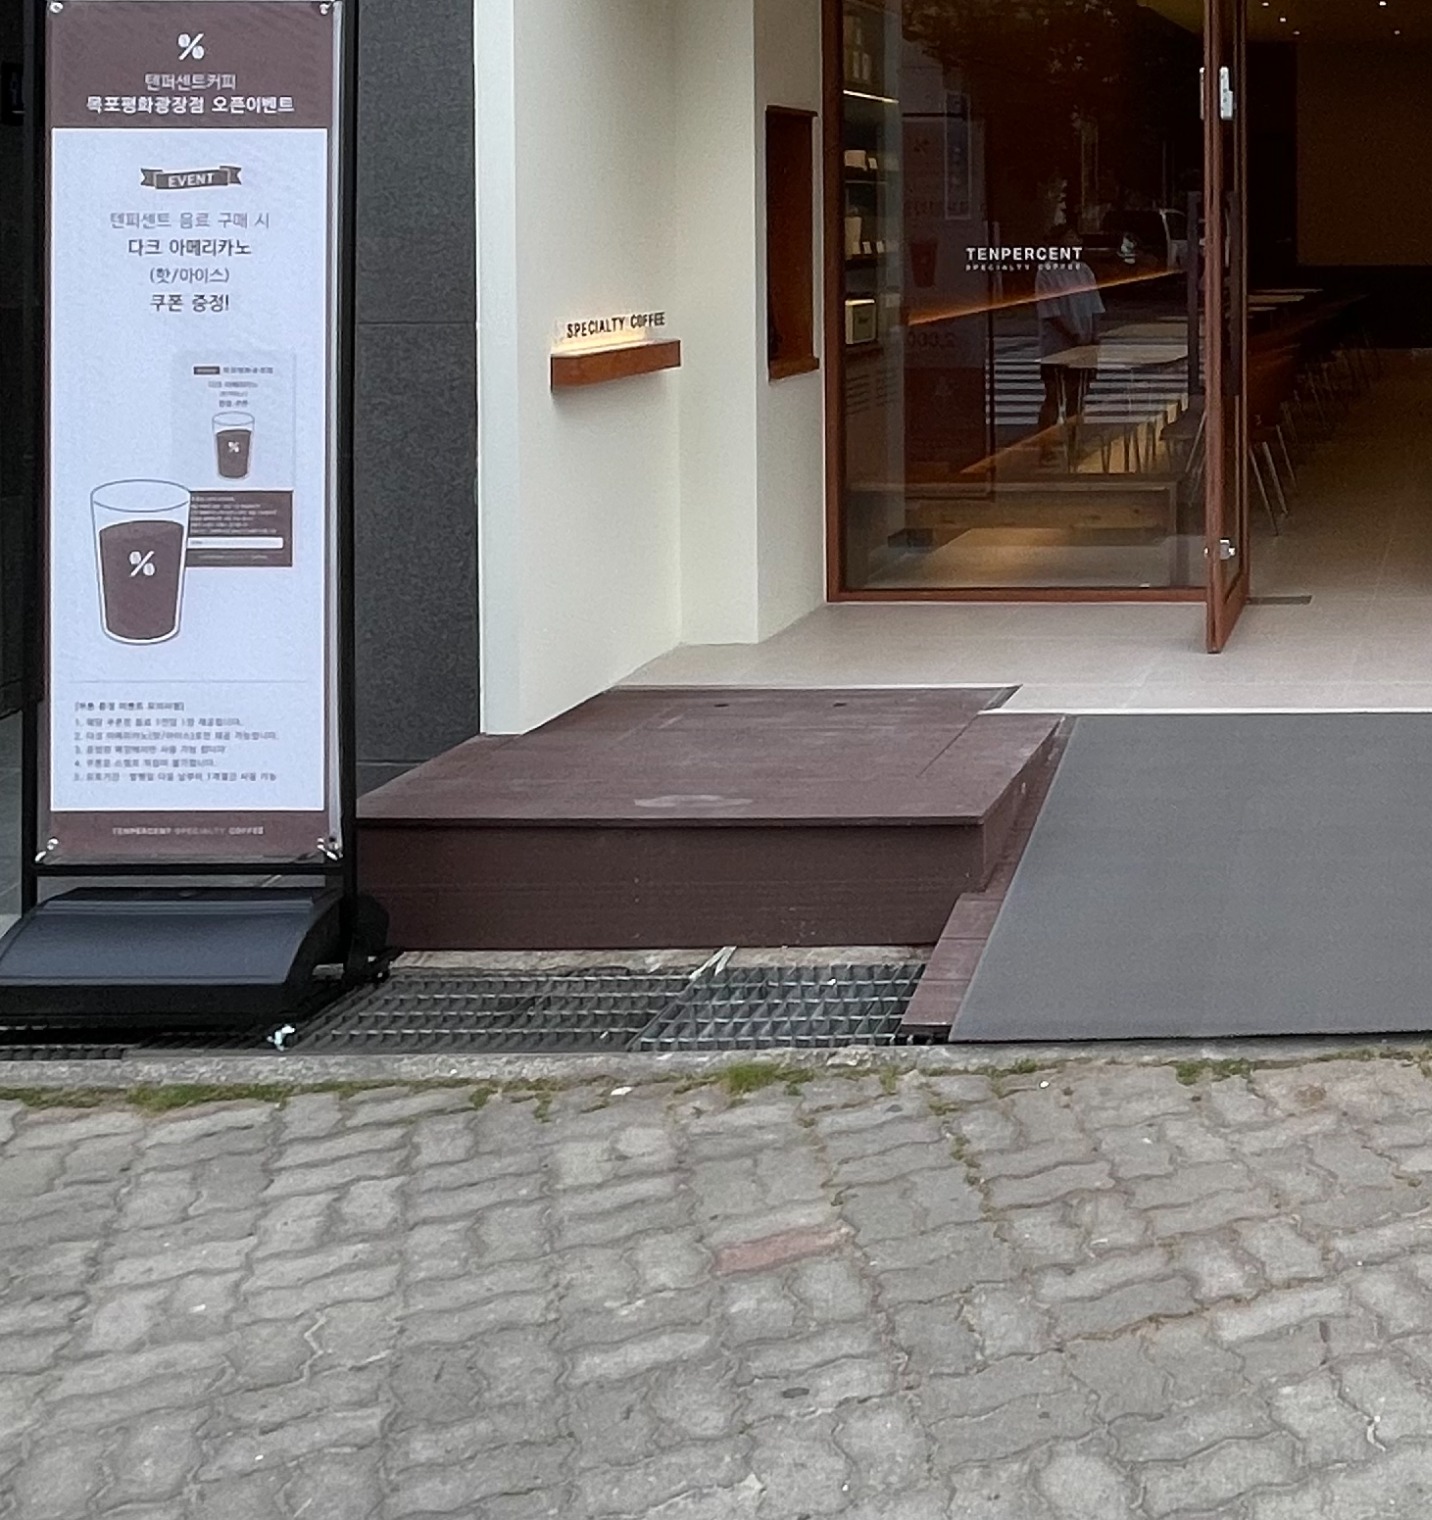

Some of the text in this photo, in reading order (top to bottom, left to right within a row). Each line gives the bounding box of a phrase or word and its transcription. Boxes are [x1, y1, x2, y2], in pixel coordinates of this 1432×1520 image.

[86, 96, 295, 114] 목포평화광장점 오픈이벤트
[168, 172, 215, 188] EVENT
[180, 212, 210, 229] 음료
[218, 212, 248, 229] 구매
[254, 212, 269, 229] 시
[128, 239, 252, 256] 다크 아메리카노
[966, 247, 1083, 261] TENPERCENT
[150, 267, 230, 284] (핫/아이스)
[150, 294, 229, 312] 쿠폰 증정!
[567, 311, 665, 338] SPECIALTY COFFEE
